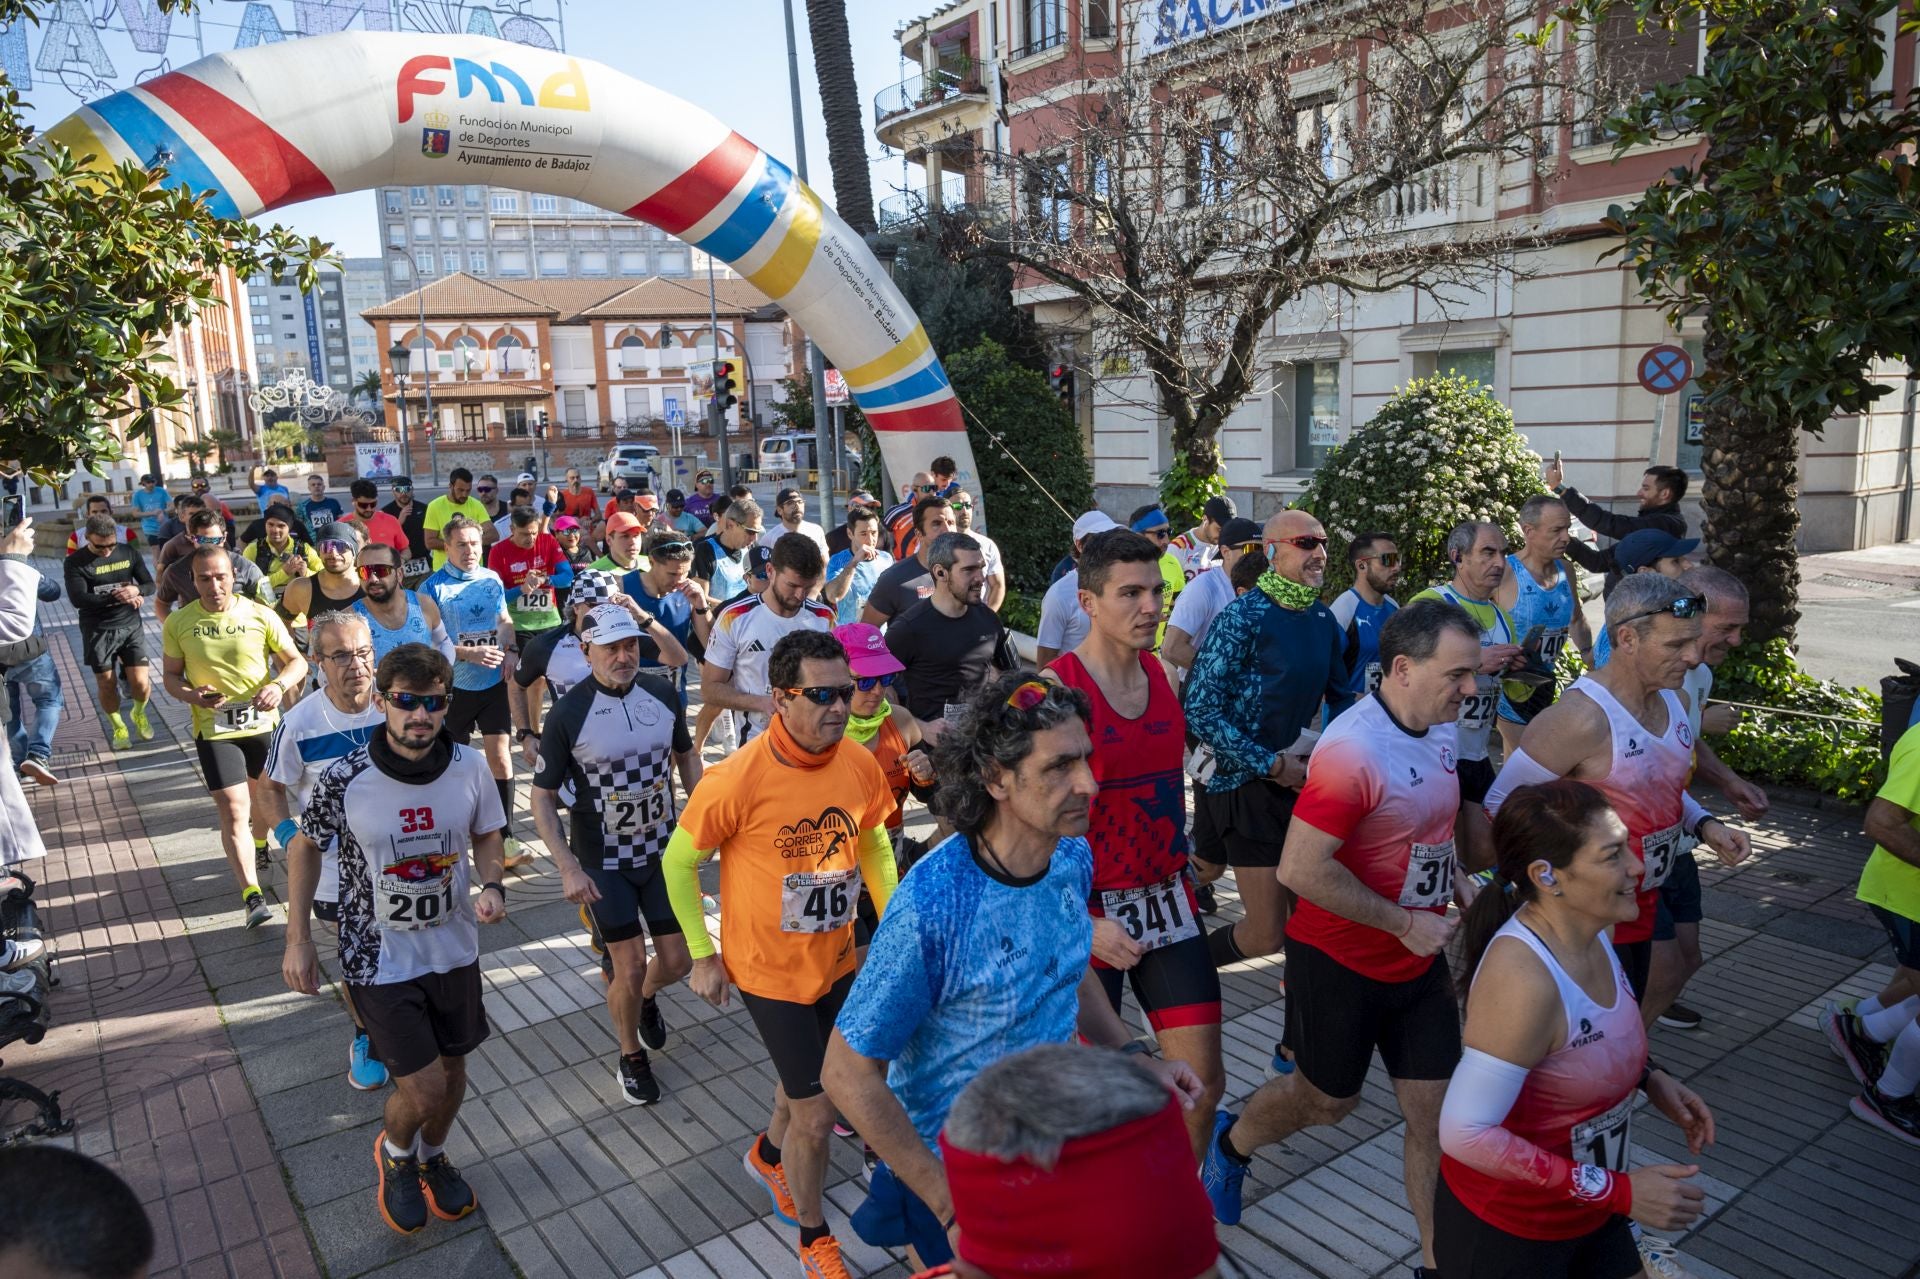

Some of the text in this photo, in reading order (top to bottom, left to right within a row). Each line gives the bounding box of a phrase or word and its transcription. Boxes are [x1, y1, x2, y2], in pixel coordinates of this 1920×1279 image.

[459, 114, 573, 136] Fundación Municipal
[459, 131, 530, 148] de Deportes
[457, 150, 590, 173] Ayuntamiento de Badajoz
[830, 235, 896, 320] Fundación Municipal
[823, 245, 902, 345] de Deportes de Badajoz
[405, 562, 426, 574] 357
[521, 593, 548, 608] 120
[193, 626, 220, 638] RUN
[225, 624, 246, 635] ON
[1624, 747, 1645, 760] VIATOR
[399, 806, 435, 834] 33
[615, 792, 664, 828] 213
[774, 832, 823, 849] CORRER
[781, 844, 825, 859] QUELUZ
[388, 883, 453, 922] 201
[803, 882, 848, 922] 46
[1116, 890, 1184, 941] 341
[996, 946, 1029, 970] VIATOR
[1571, 1030, 1605, 1048] VIATOR
